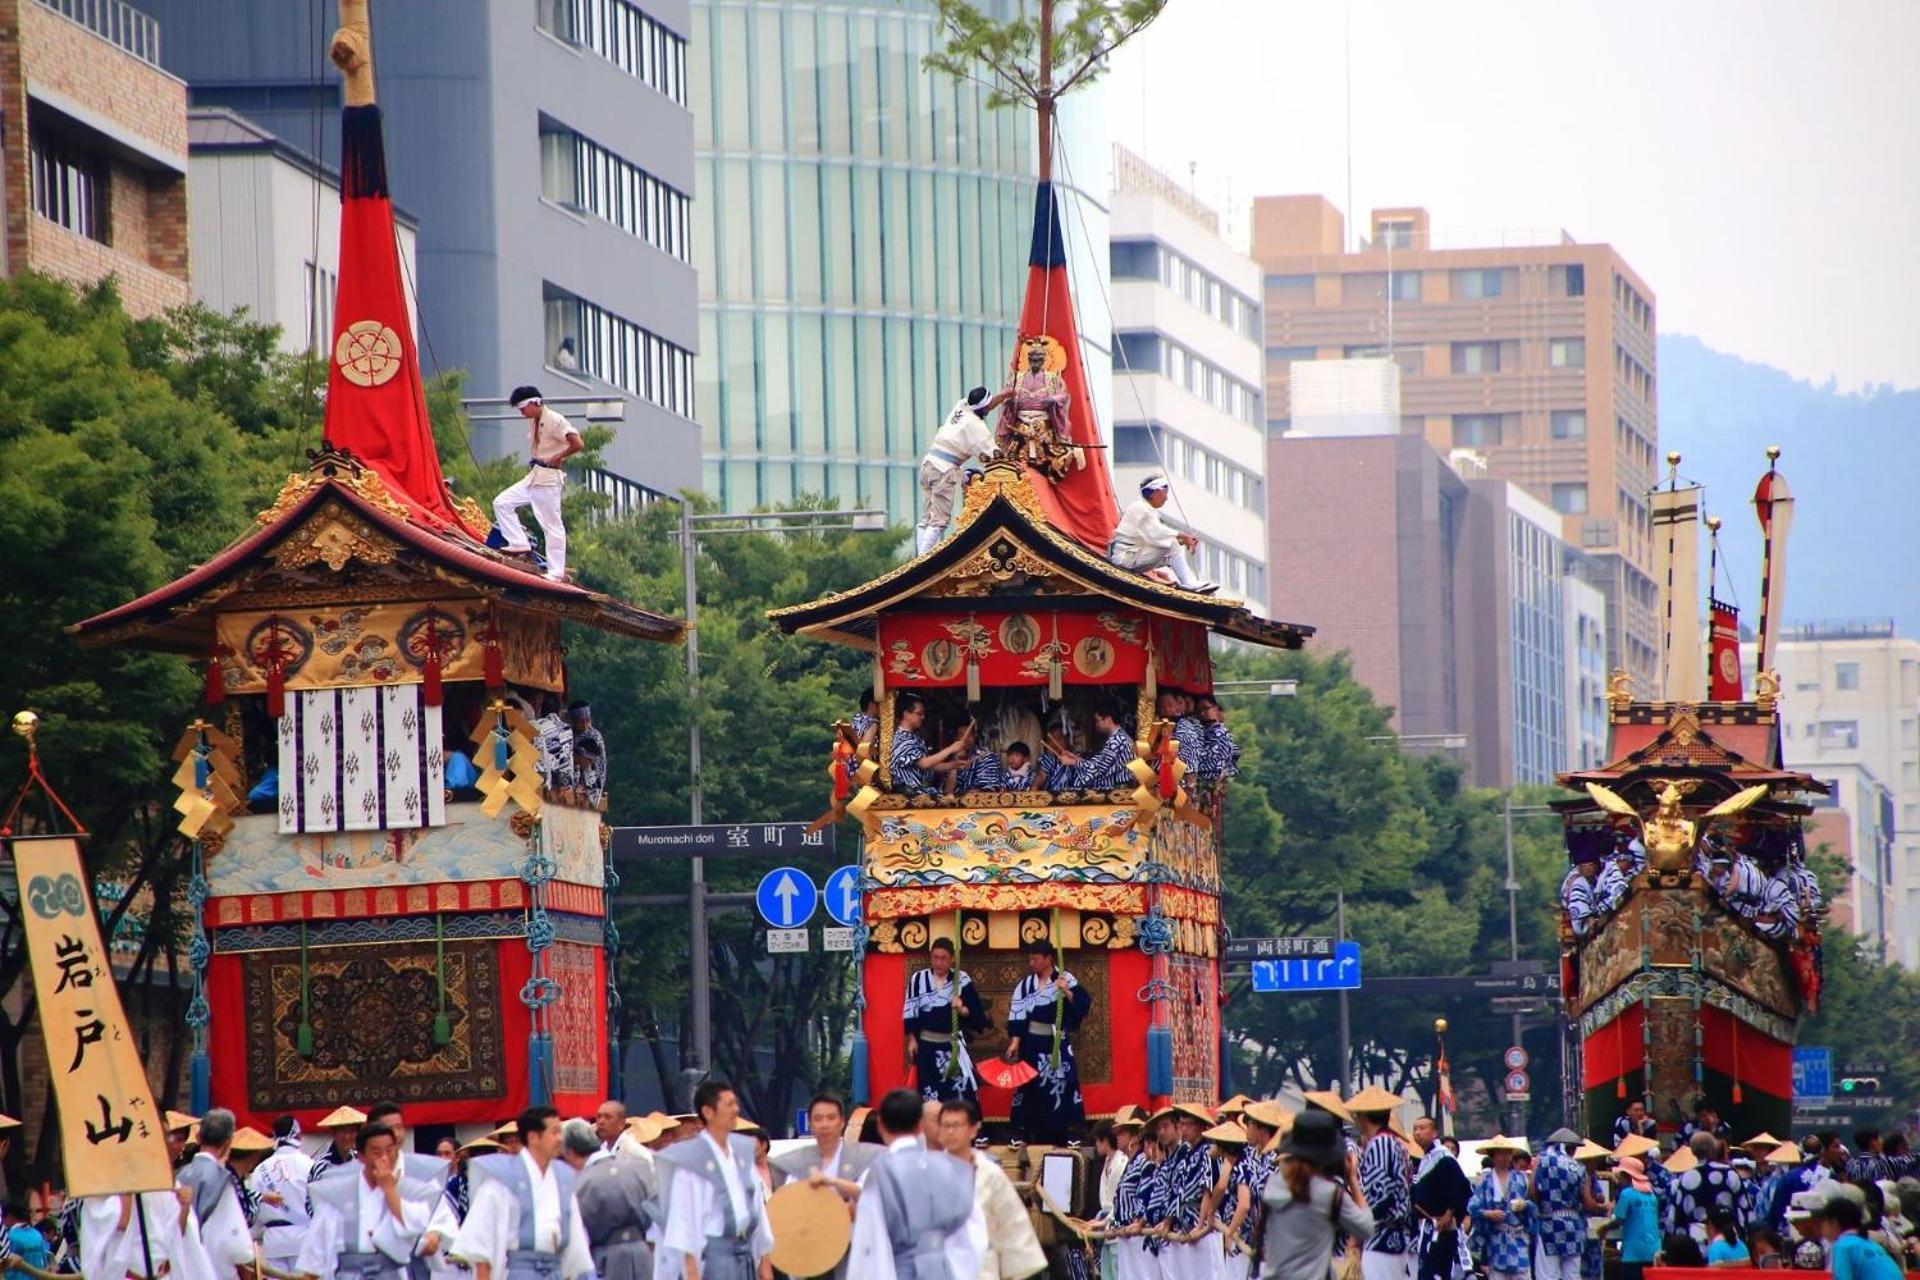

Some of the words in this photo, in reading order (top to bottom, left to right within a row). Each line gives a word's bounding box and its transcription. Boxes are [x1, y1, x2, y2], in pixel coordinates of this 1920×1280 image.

[638, 834, 693, 845] Muromachi
[696, 833, 715, 844] dori
[726, 826, 824, 847] 室町通
[1257, 938, 1329, 956] 両替町通
[53, 933, 133, 1146] 岩戸山
